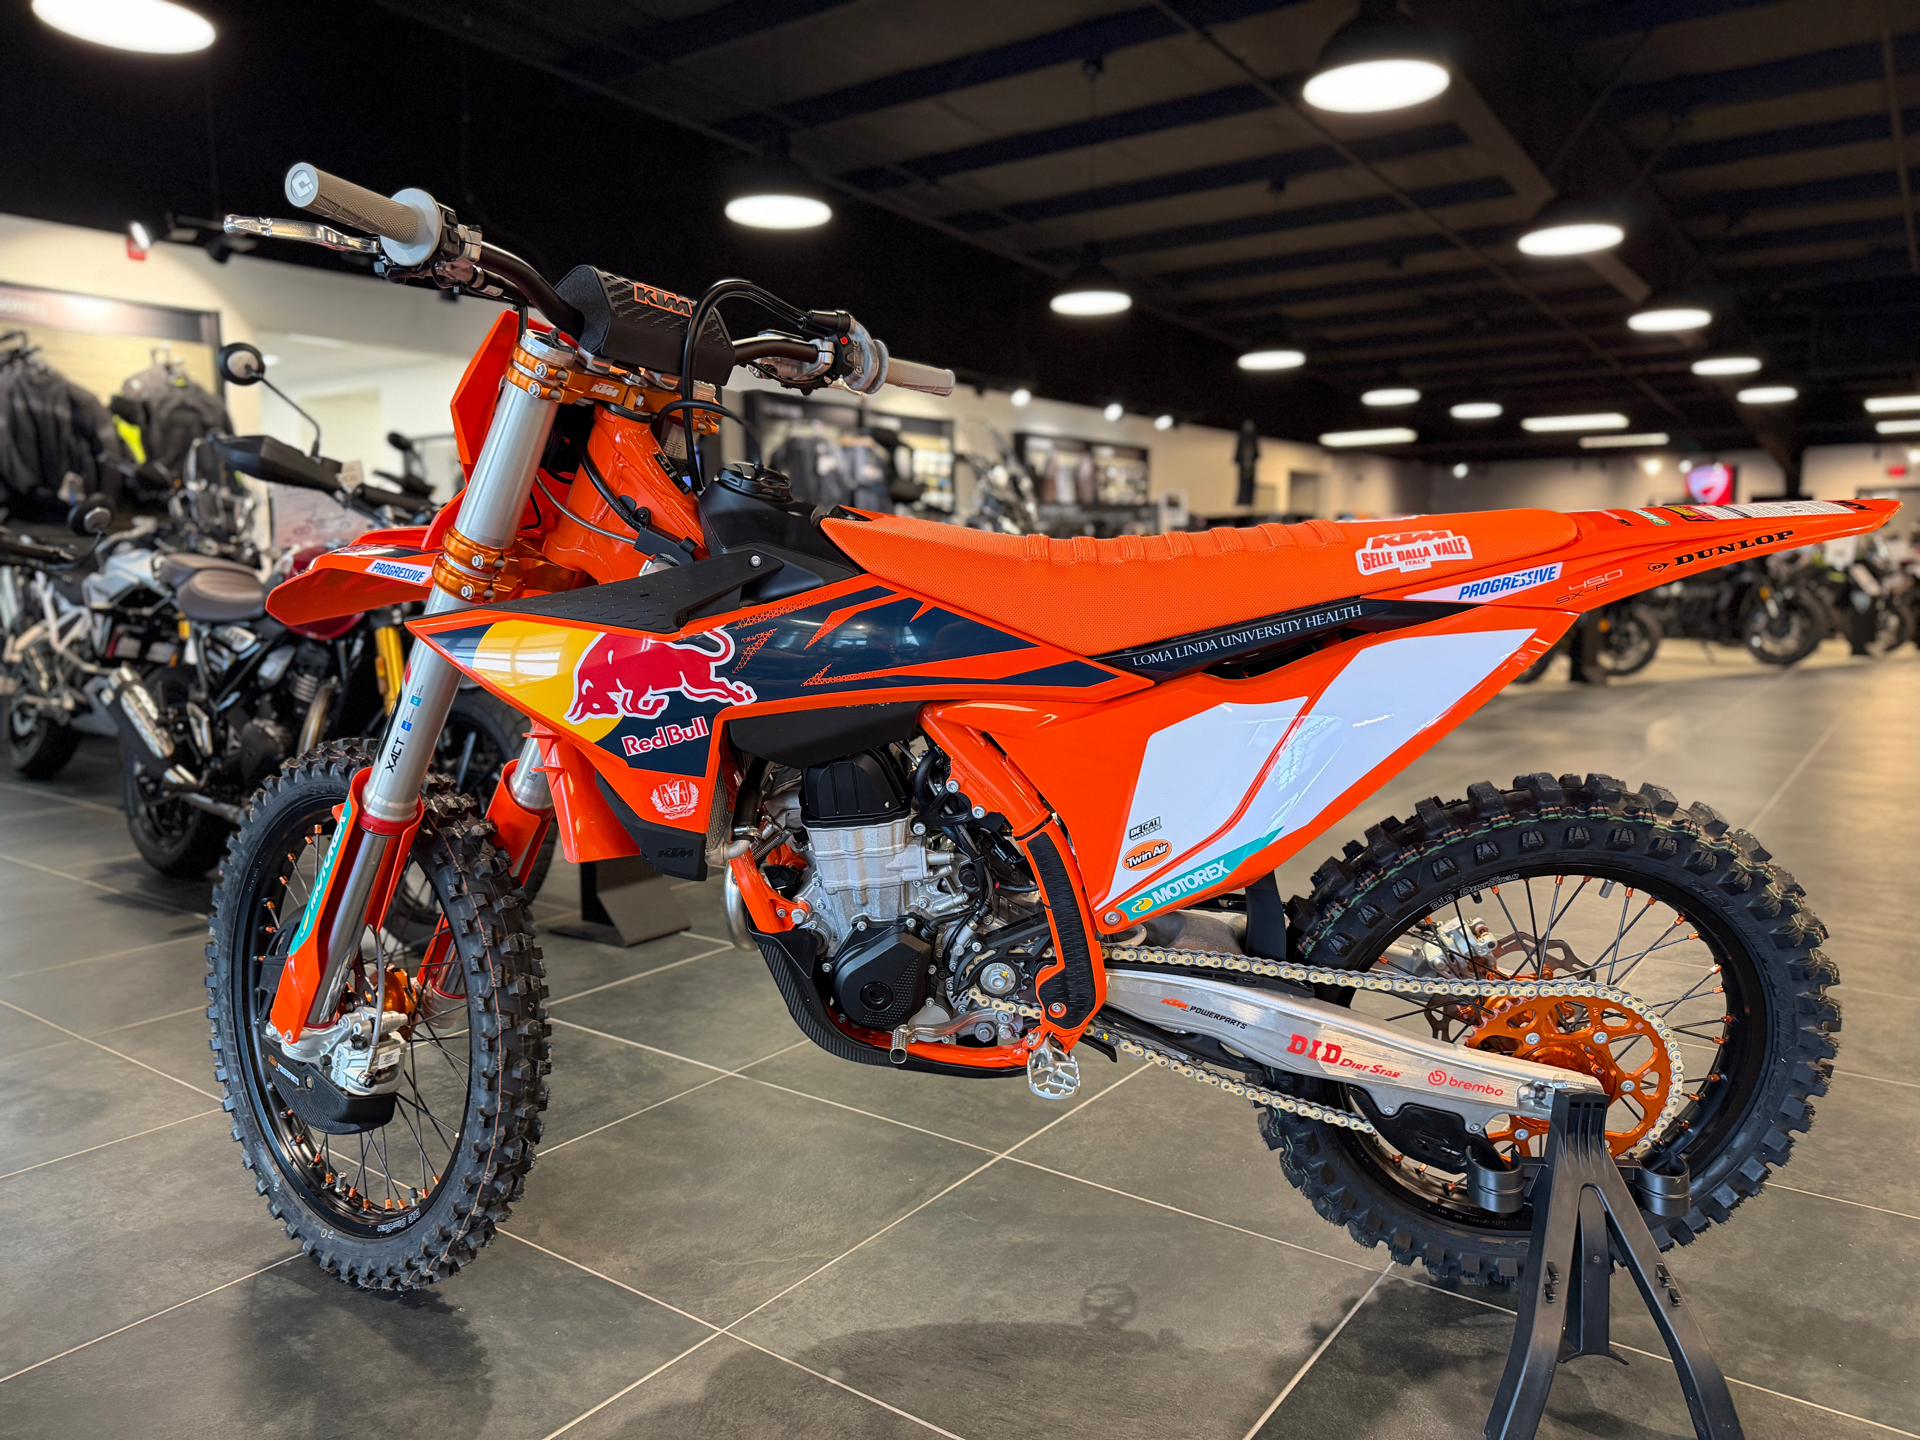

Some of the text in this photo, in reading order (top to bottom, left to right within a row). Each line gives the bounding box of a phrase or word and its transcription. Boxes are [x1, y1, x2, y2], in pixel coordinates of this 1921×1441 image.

[634, 284, 693, 317] KTM
[591, 383, 619, 398] KTM
[1370, 529, 1450, 550] KTM
[1674, 530, 1794, 566] DUNLOP
[1361, 538, 1467, 571] SELLE DALLA VALLE
[1405, 558, 1426, 567] ITALY
[371, 562, 426, 582] PROGRESSIVE
[1458, 566, 1557, 600] PROGRESSIVE
[1569, 569, 1623, 590] 450
[1556, 581, 1610, 605] SX-F
[1133, 604, 1363, 666] LOMA LINDA UNIVERSITY HEALTH
[622, 716, 709, 756] Red Bull
[385, 736, 405, 773] XACT
[1129, 817, 1161, 838] DECAL
[657, 847, 695, 858] KTM
[1126, 843, 1169, 868] Twin Air
[1151, 860, 1231, 905] MOTOREX
[1161, 997, 1248, 1030] KTM POWERPARTS
[1449, 1076, 1504, 1097] brembo
